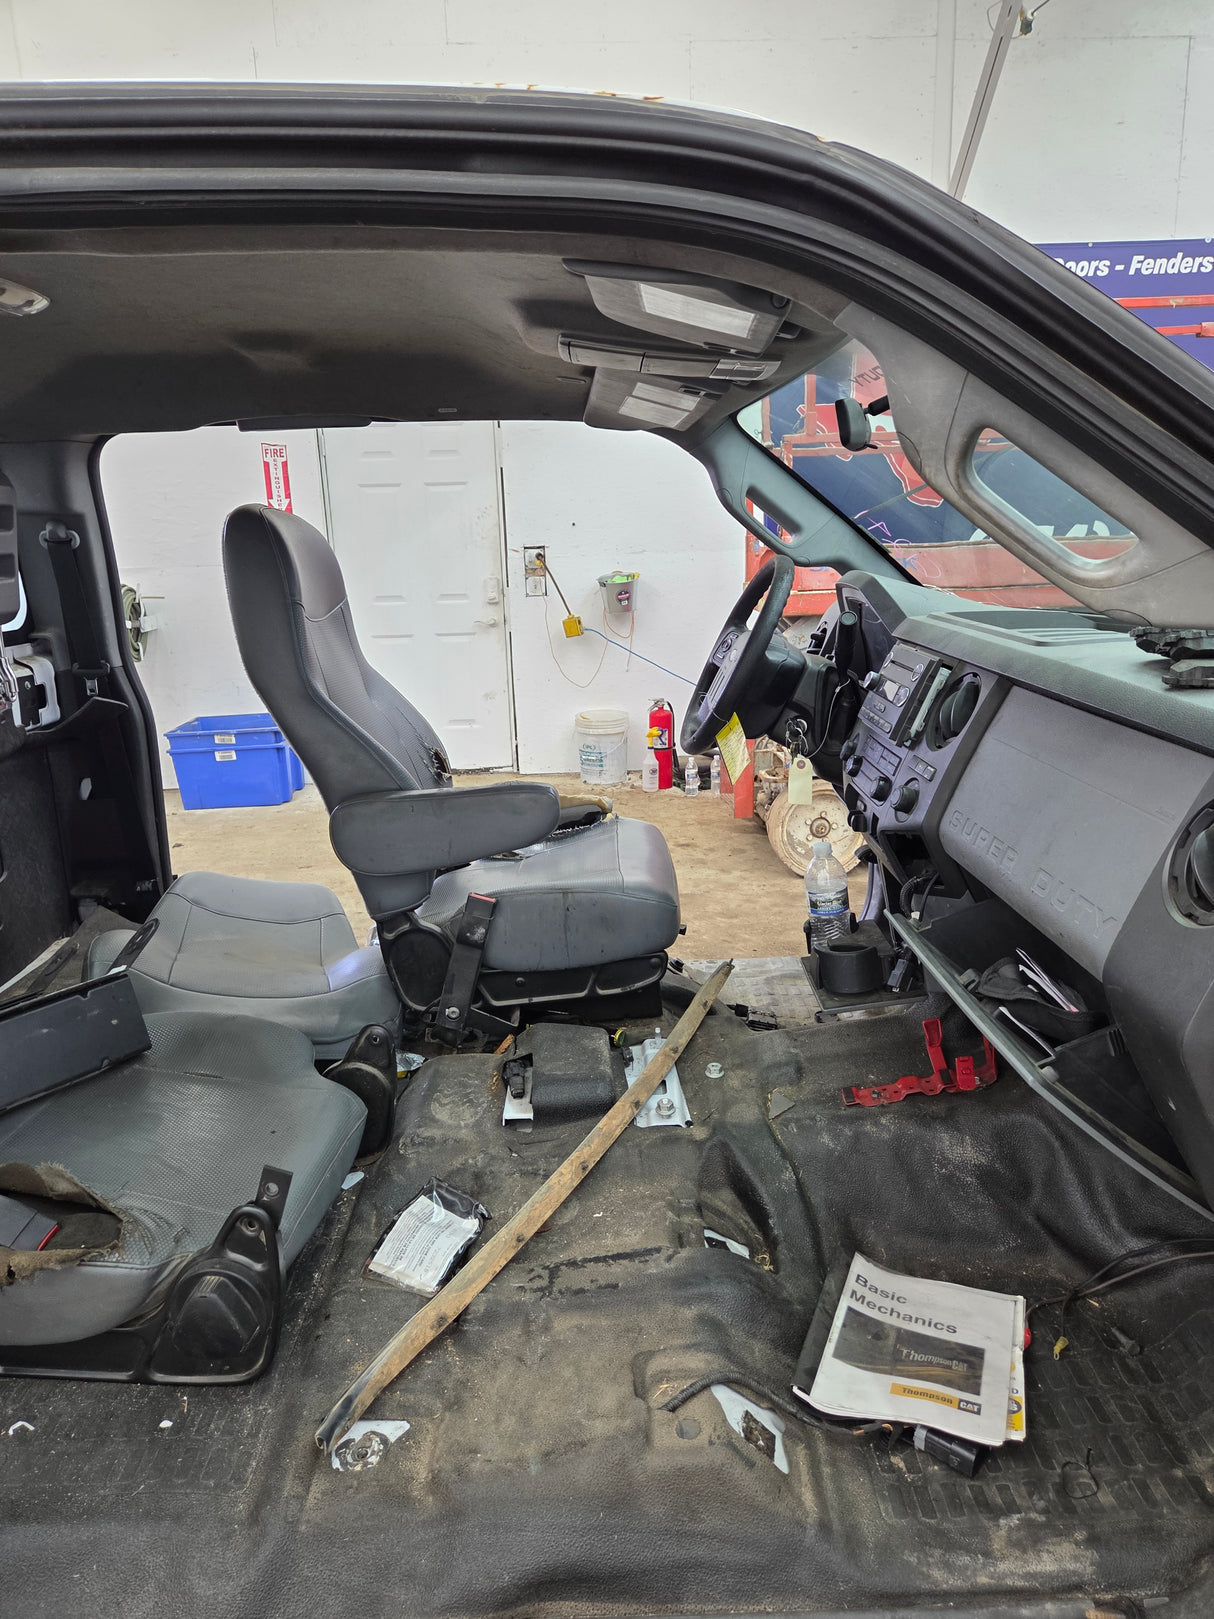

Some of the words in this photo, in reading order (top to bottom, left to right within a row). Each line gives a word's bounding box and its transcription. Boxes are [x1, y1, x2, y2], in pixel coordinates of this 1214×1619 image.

[1128, 252, 1214, 276] Fenders
[264, 448, 285, 458] FIRE
[949, 809, 1020, 874] SUPER
[1031, 866, 1118, 939] DUTY
[855, 1273, 908, 1304] Basic
[850, 1289, 958, 1334] Mechanics
[902, 1387, 953, 1404] Thompson
[960, 1400, 979, 1413] CAT
